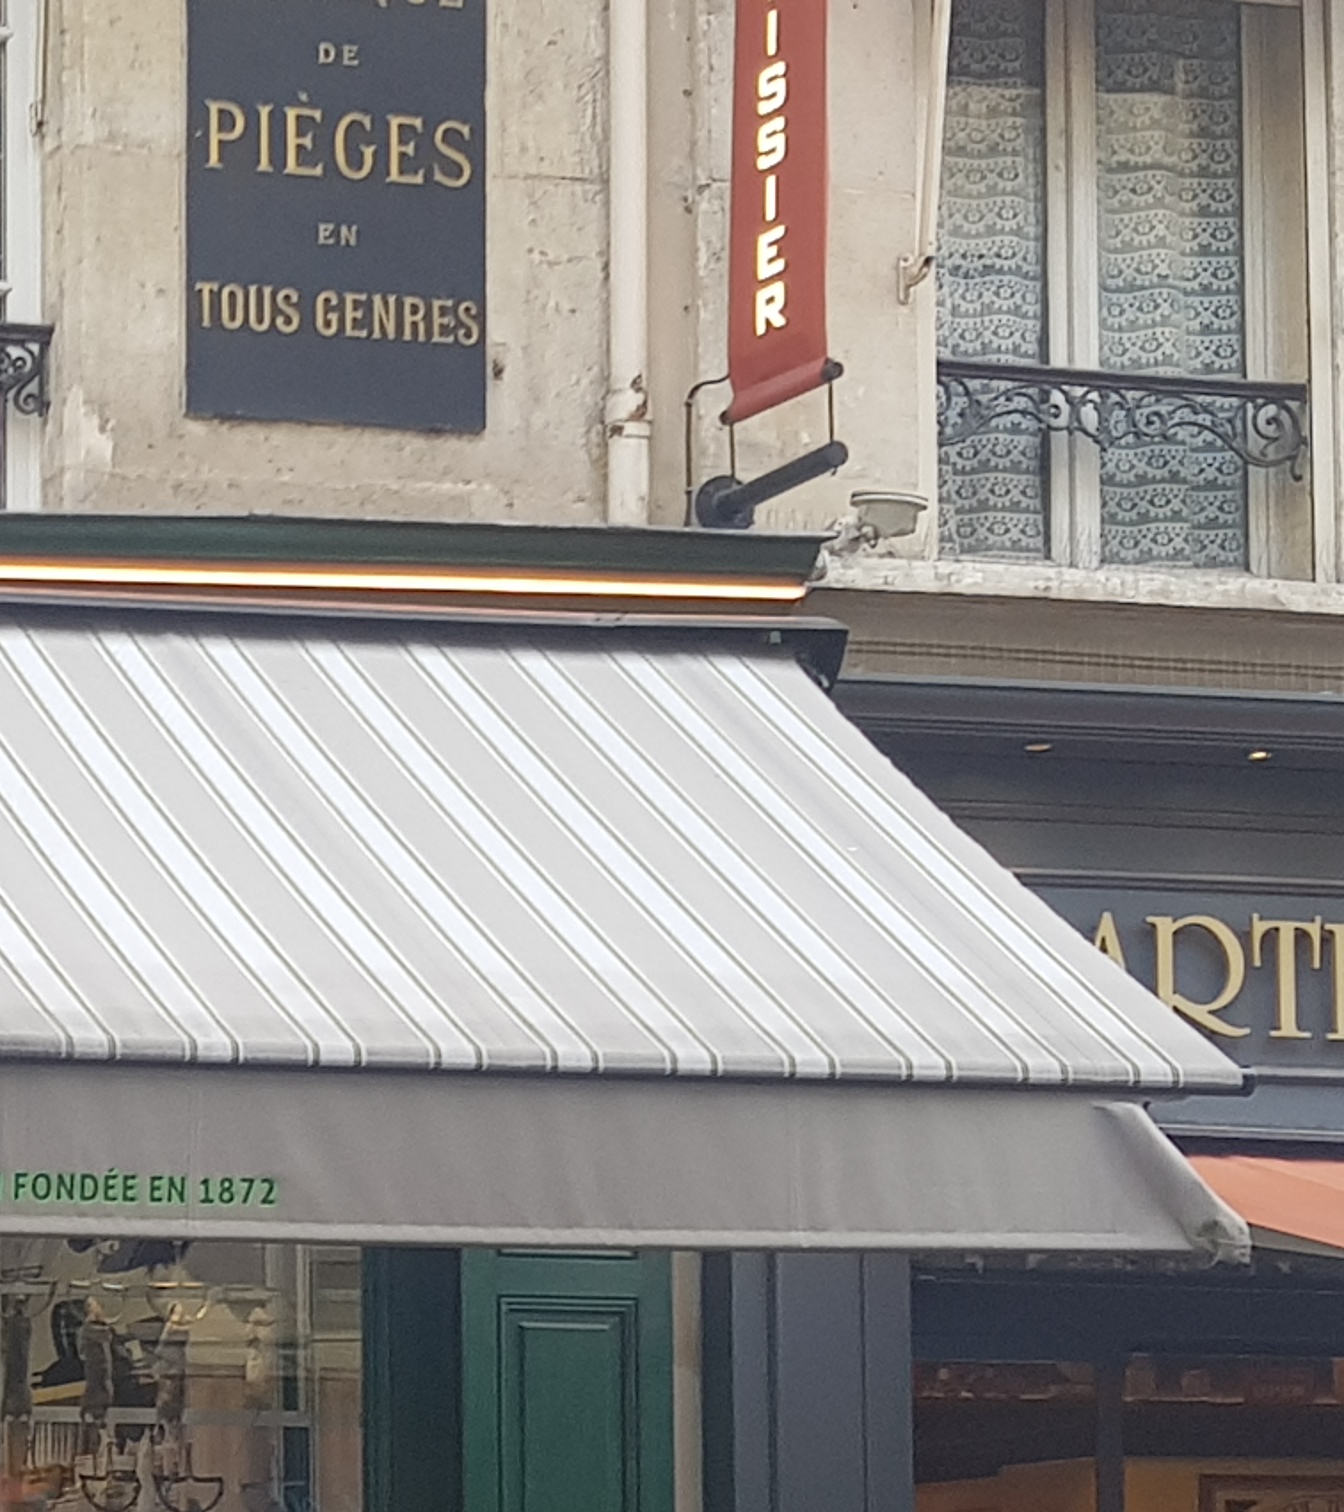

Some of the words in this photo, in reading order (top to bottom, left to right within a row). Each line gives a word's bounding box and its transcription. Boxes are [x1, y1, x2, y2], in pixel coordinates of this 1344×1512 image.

[318, 41, 359, 66] DE
[204, 91, 472, 188] PIÈGES
[317, 222, 358, 246] EN
[194, 279, 301, 335] TOUS
[315, 289, 479, 347] GENRES
[13, 1168, 138, 1203] FONDÉE
[149, 1176, 186, 1204] EN
[199, 1178, 278, 1206] 1872
